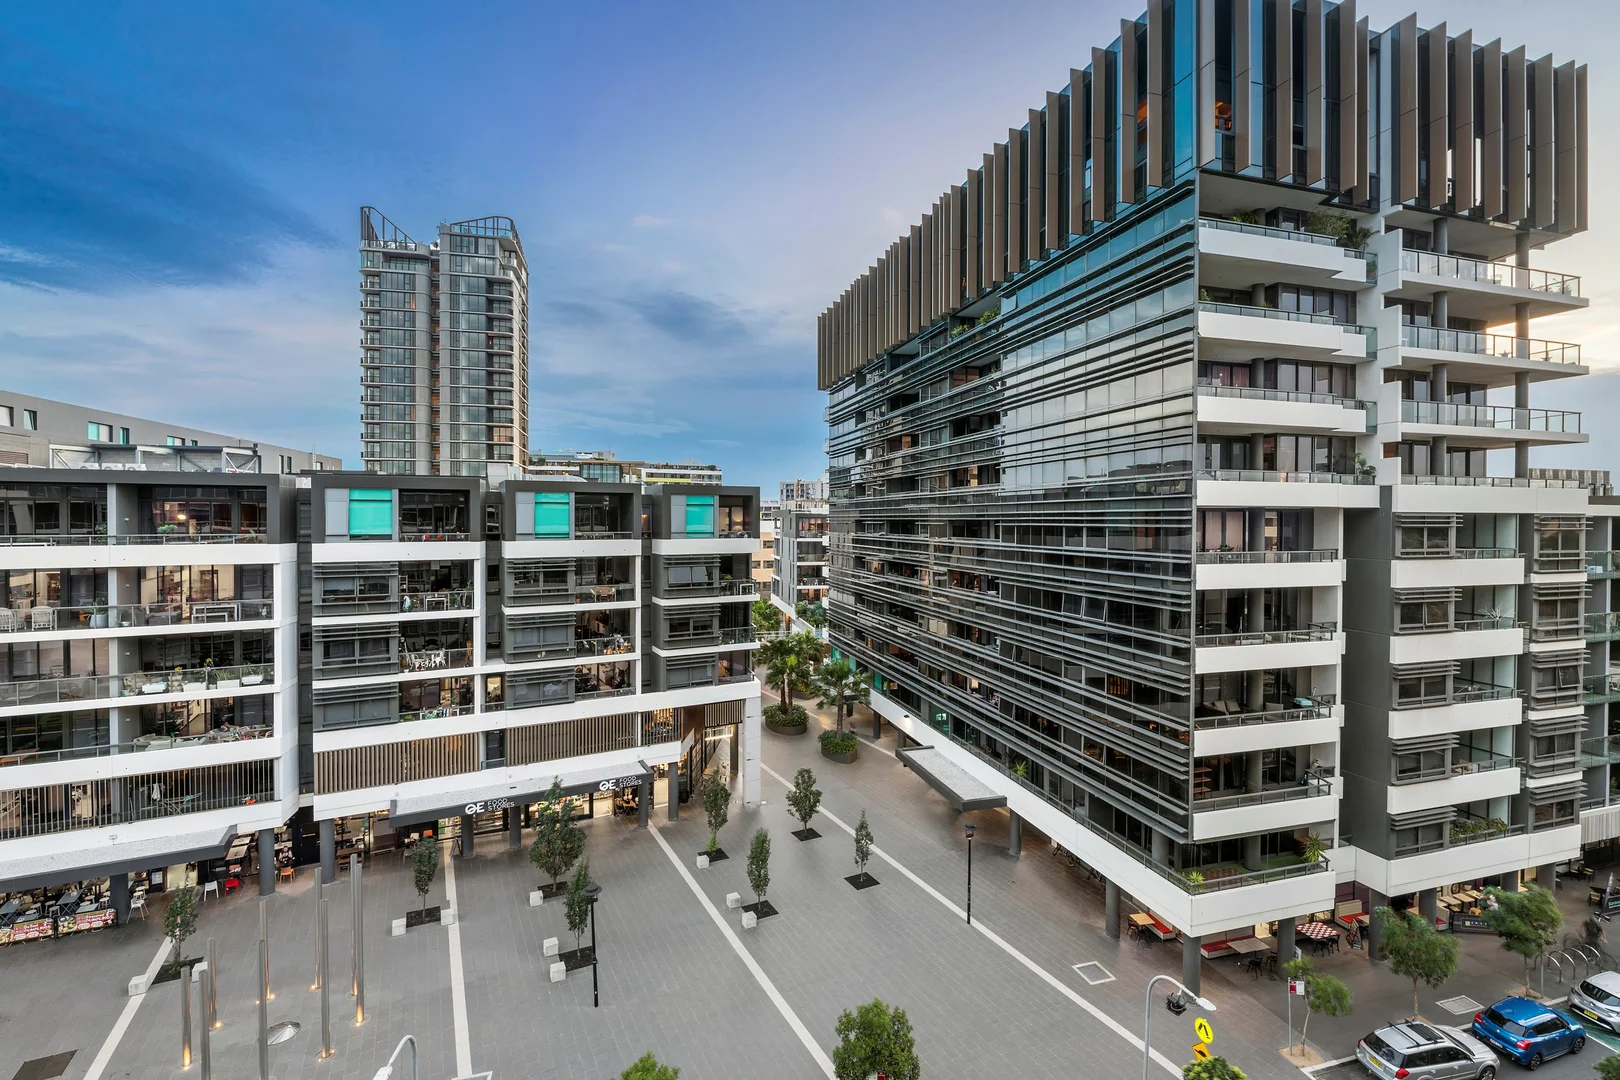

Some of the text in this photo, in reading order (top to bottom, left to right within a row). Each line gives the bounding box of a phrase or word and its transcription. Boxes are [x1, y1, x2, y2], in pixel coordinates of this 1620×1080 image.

[620, 780, 642, 788] STORES
[488, 798, 508, 806] FOOD
[488, 802, 515, 811] STORES
